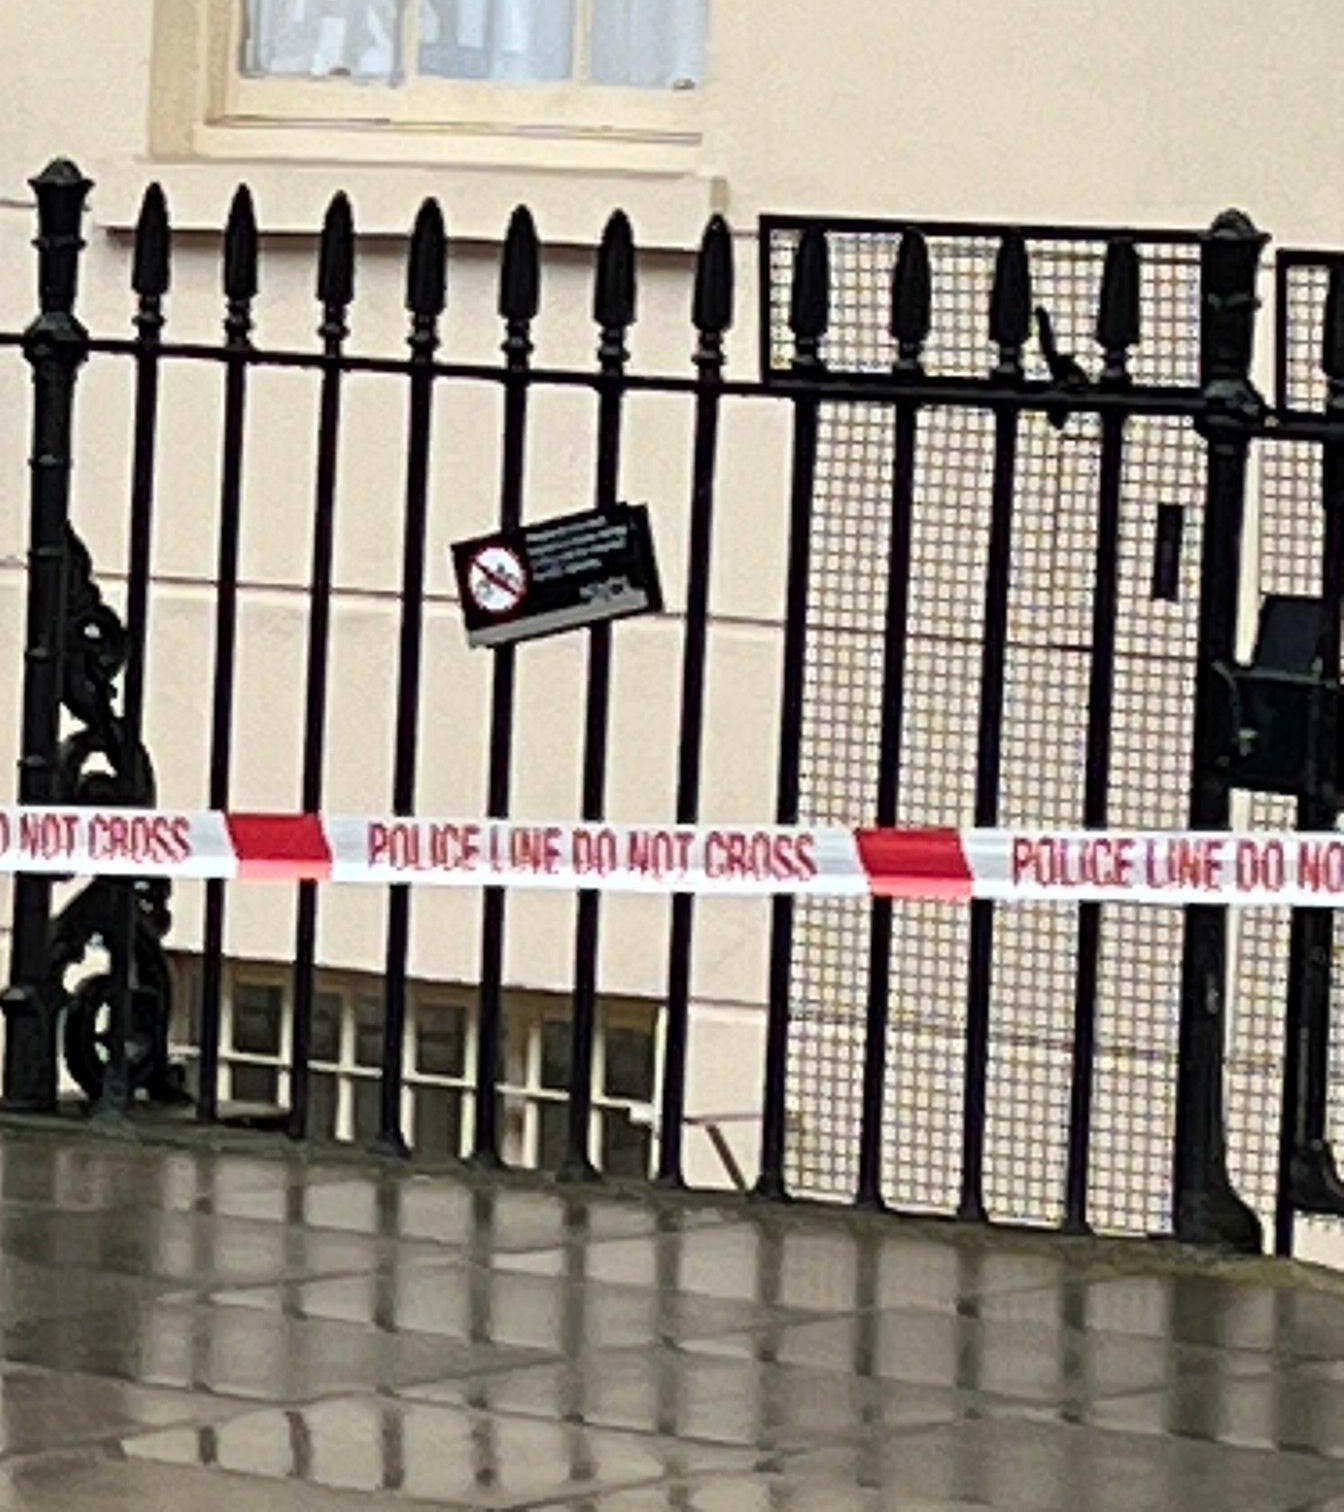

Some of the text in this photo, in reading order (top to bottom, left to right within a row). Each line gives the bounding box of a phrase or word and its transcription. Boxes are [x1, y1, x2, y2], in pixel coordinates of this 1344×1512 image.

[18, 813, 79, 861] NOT
[87, 815, 191, 864] CROSS
[367, 821, 817, 881] POLICE LINE DO NOT CROSS
[1012, 836, 1134, 888] POLICE
[1145, 839, 1223, 891] LINE
[1236, 840, 1284, 892] DO
